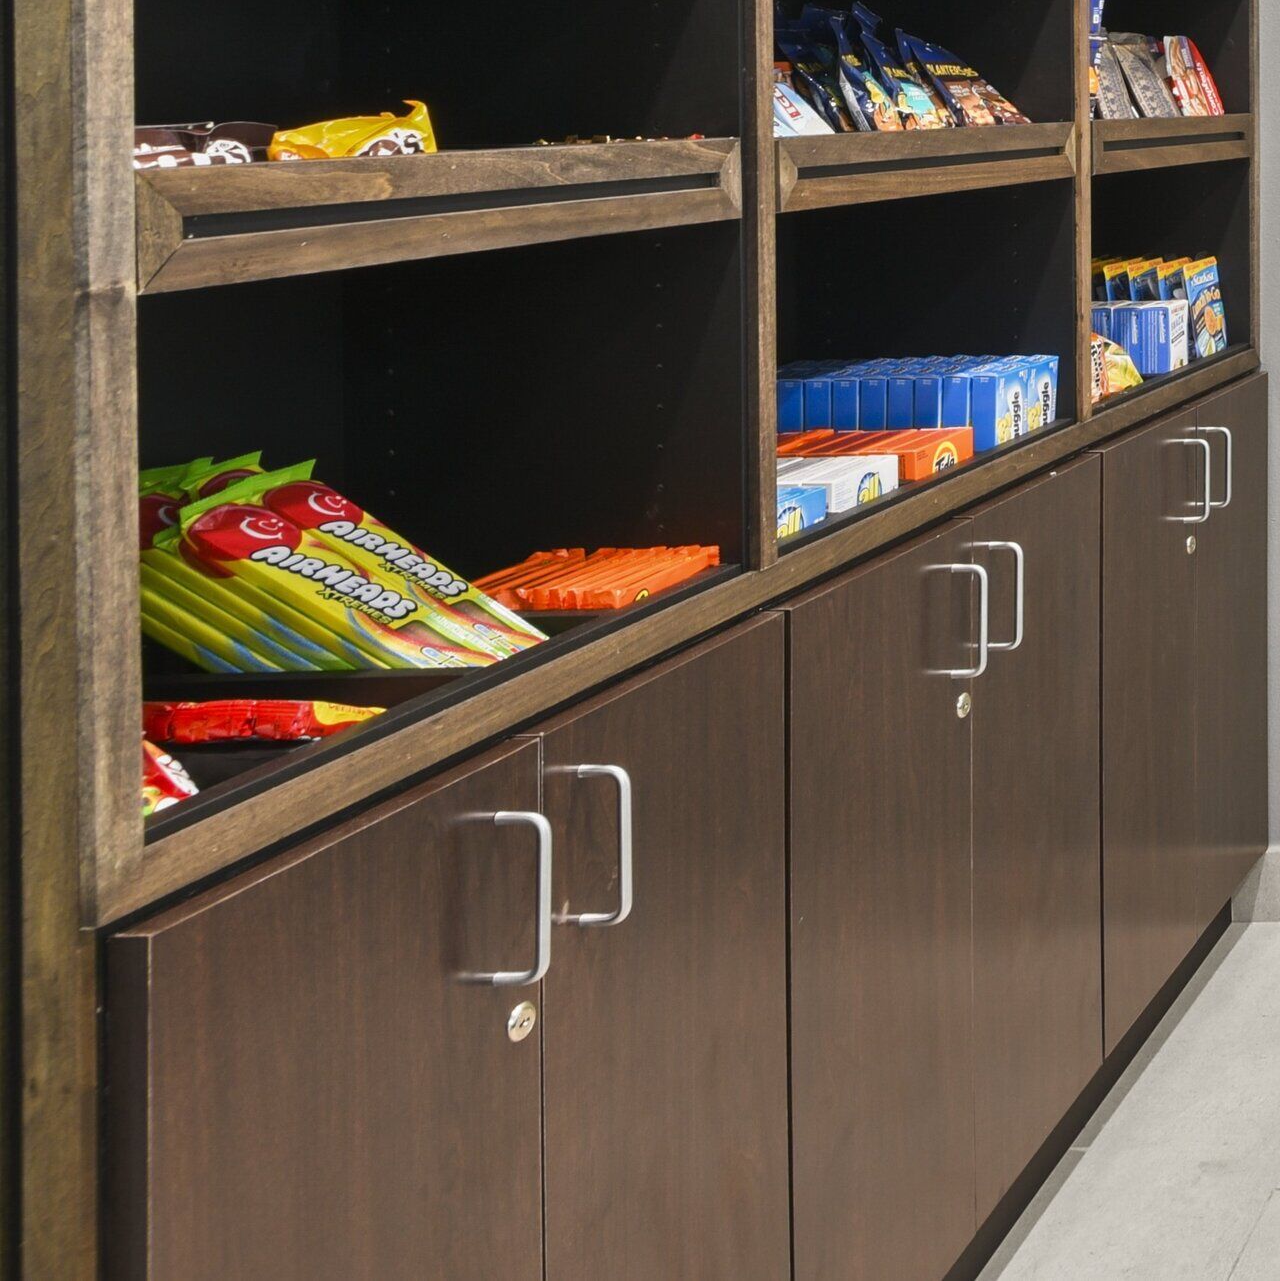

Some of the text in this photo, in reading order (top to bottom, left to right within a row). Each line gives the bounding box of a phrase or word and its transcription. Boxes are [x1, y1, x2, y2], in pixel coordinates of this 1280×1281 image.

[251, 545, 418, 619] AIRHEADS
[319, 519, 469, 597] AIRHEADS
[379, 561, 448, 600] XTREMES
[317, 586, 393, 625] XTREMES
